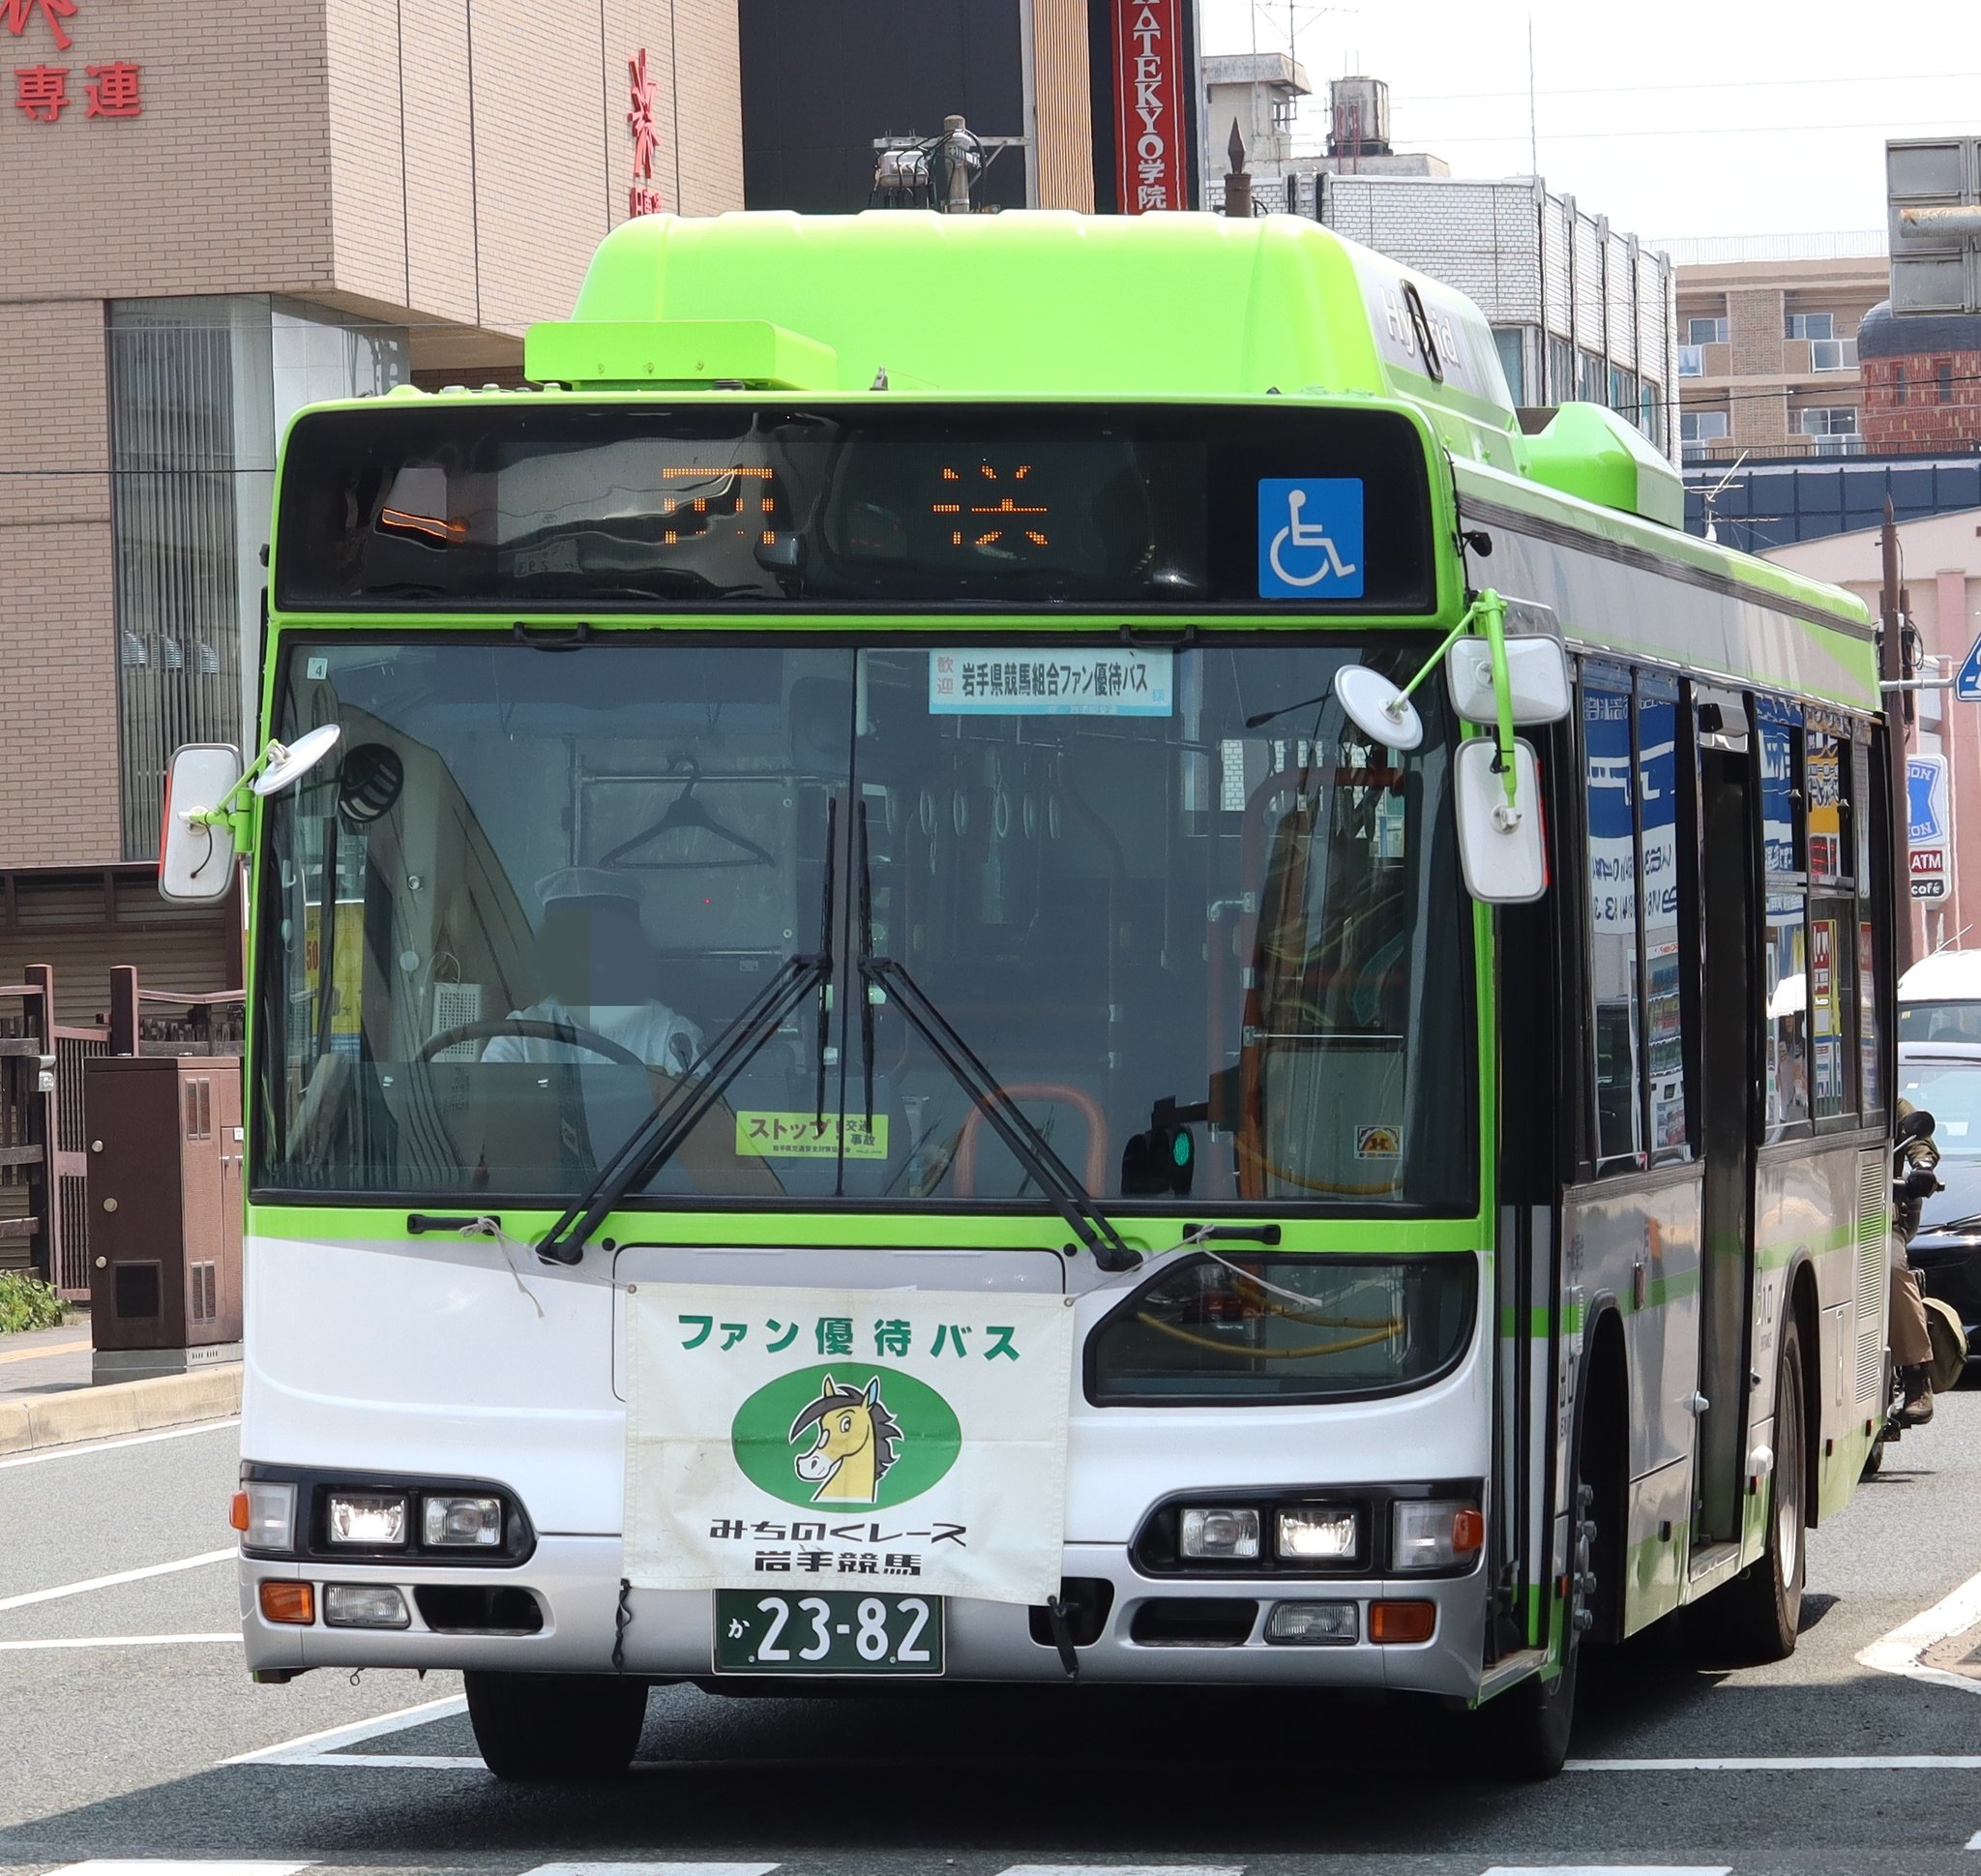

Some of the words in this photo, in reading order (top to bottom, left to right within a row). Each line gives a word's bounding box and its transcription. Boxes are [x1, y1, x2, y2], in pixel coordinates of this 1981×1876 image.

[1133, 0, 1167, 210] ATEKYO学院
[961, 662, 1148, 698] 岩手県競馬組合ファン優待バス
[1911, 853, 1941, 870] ATM
[1911, 881, 1940, 896] café
[678, 1314, 1020, 1362] ファン優待バス
[709, 1518, 966, 1547] みちのくレース
[754, 1550, 922, 1576] 岩手競馬
[727, 1617, 750, 1639] か
[756, 1596, 931, 1662] 23-82
